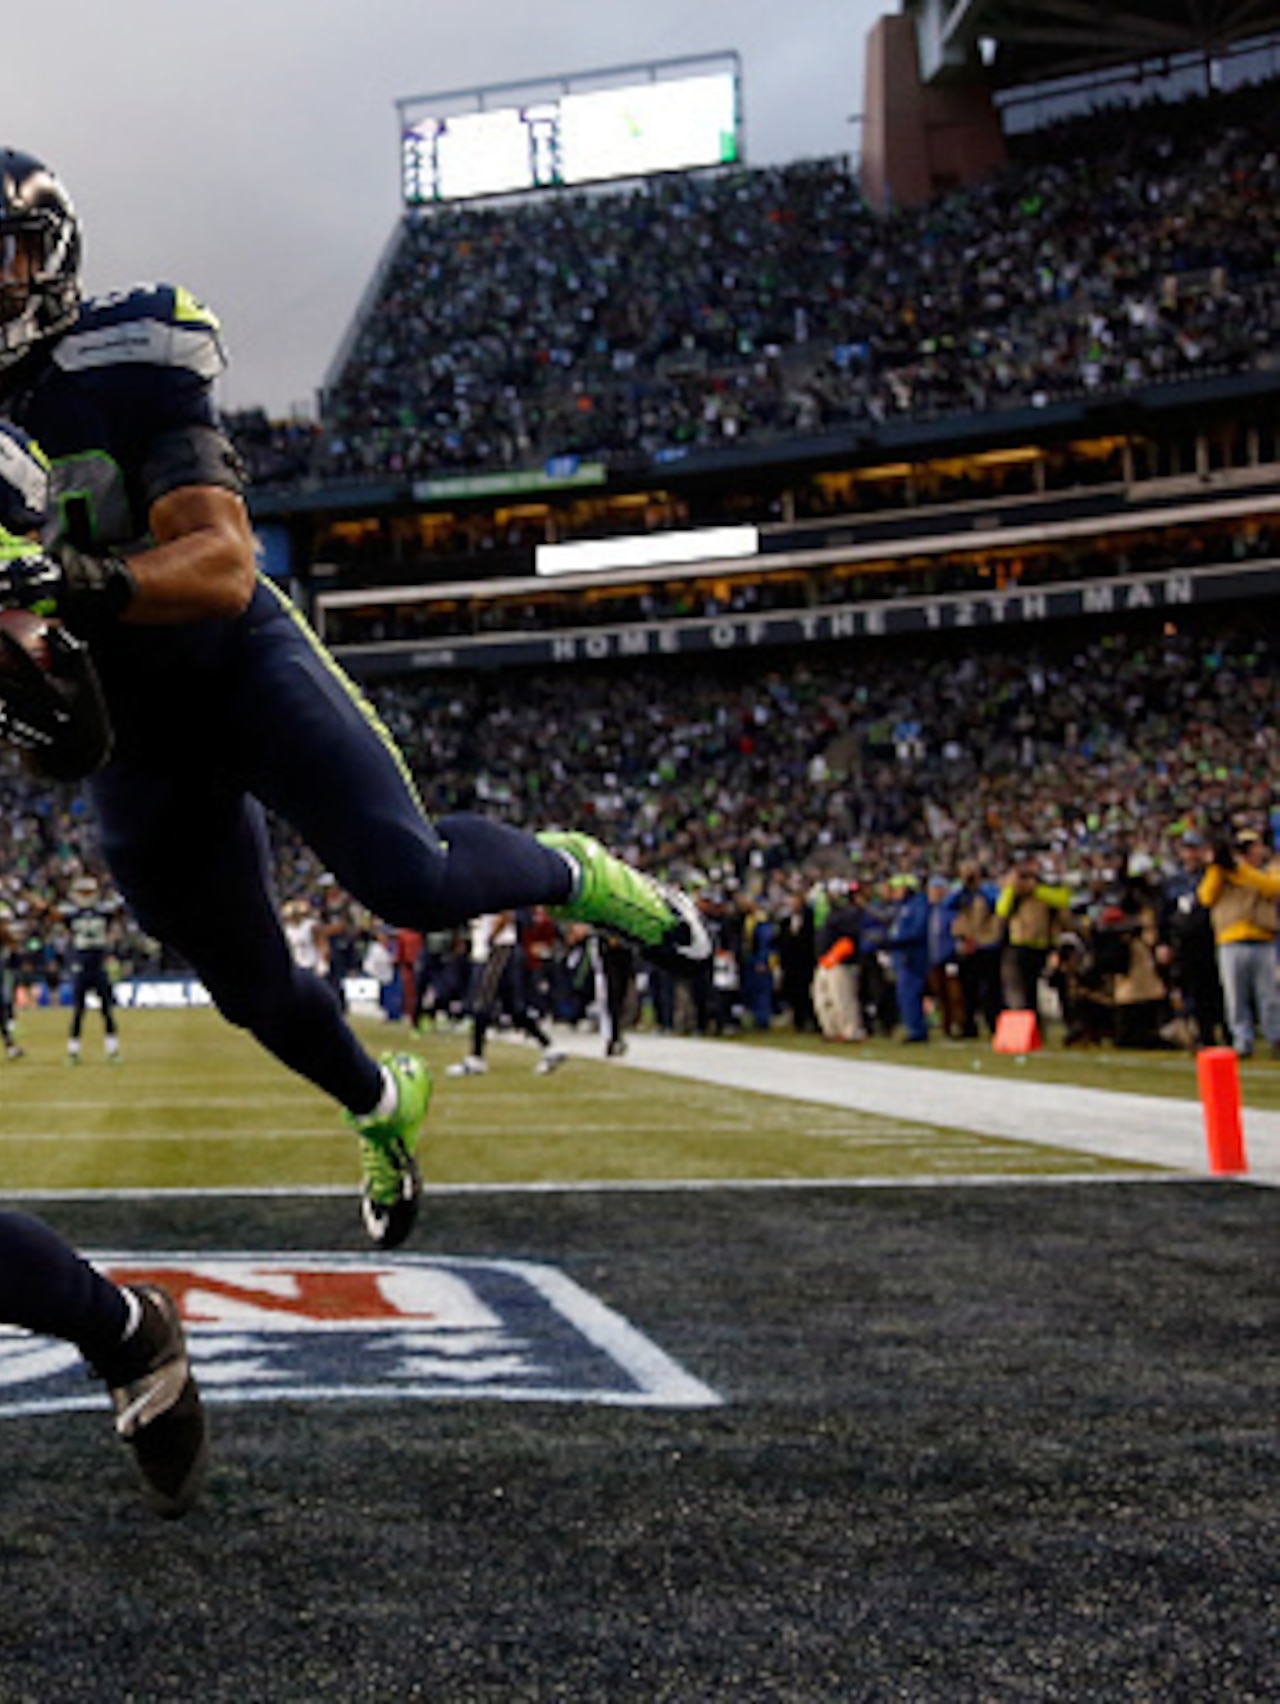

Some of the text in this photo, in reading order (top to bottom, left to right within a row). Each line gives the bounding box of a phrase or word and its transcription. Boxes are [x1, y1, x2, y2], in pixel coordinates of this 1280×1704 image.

[552, 575, 1192, 660] HOME OF THE 12TH MAN
